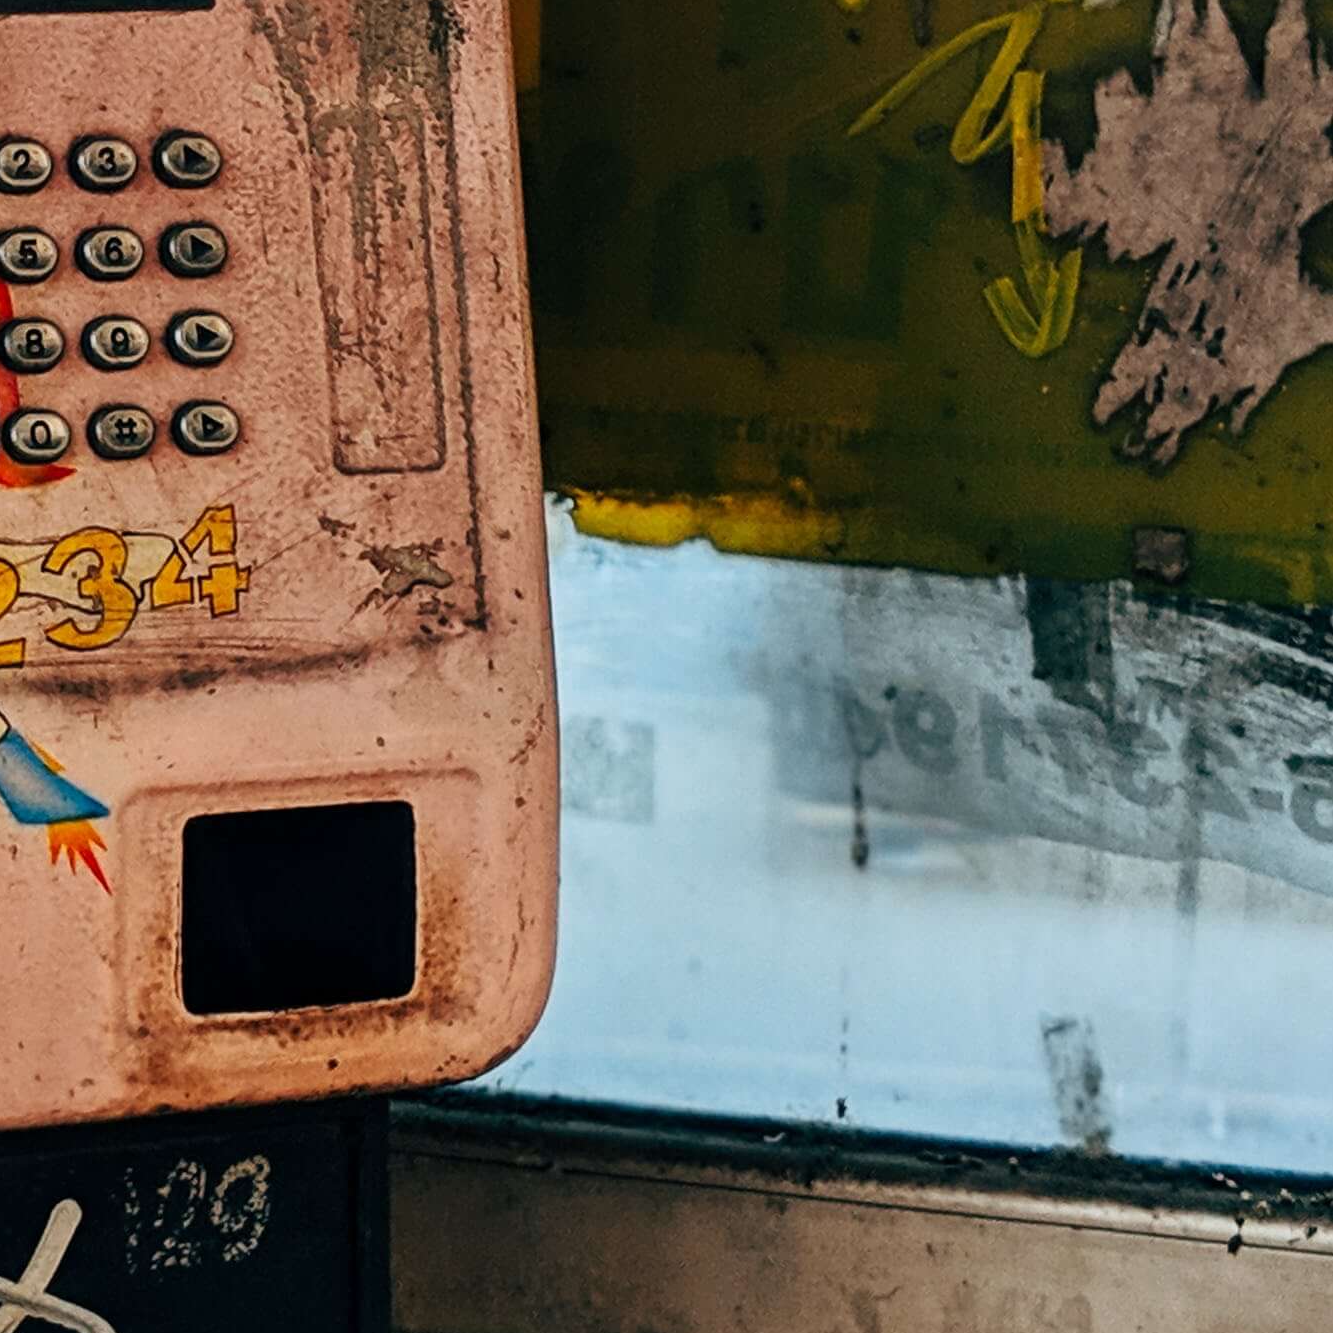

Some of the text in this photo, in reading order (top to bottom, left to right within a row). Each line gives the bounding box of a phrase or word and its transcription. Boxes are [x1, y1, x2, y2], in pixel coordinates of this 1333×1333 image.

[12, 149, 30, 174] 2
[98, 147, 116, 172] 3
[18, 239, 37, 265] 5
[105, 236, 124, 263] 6
[25, 329, 45, 356] 8
[110, 326, 129, 354] 9
[30, 420, 51, 446] 0
